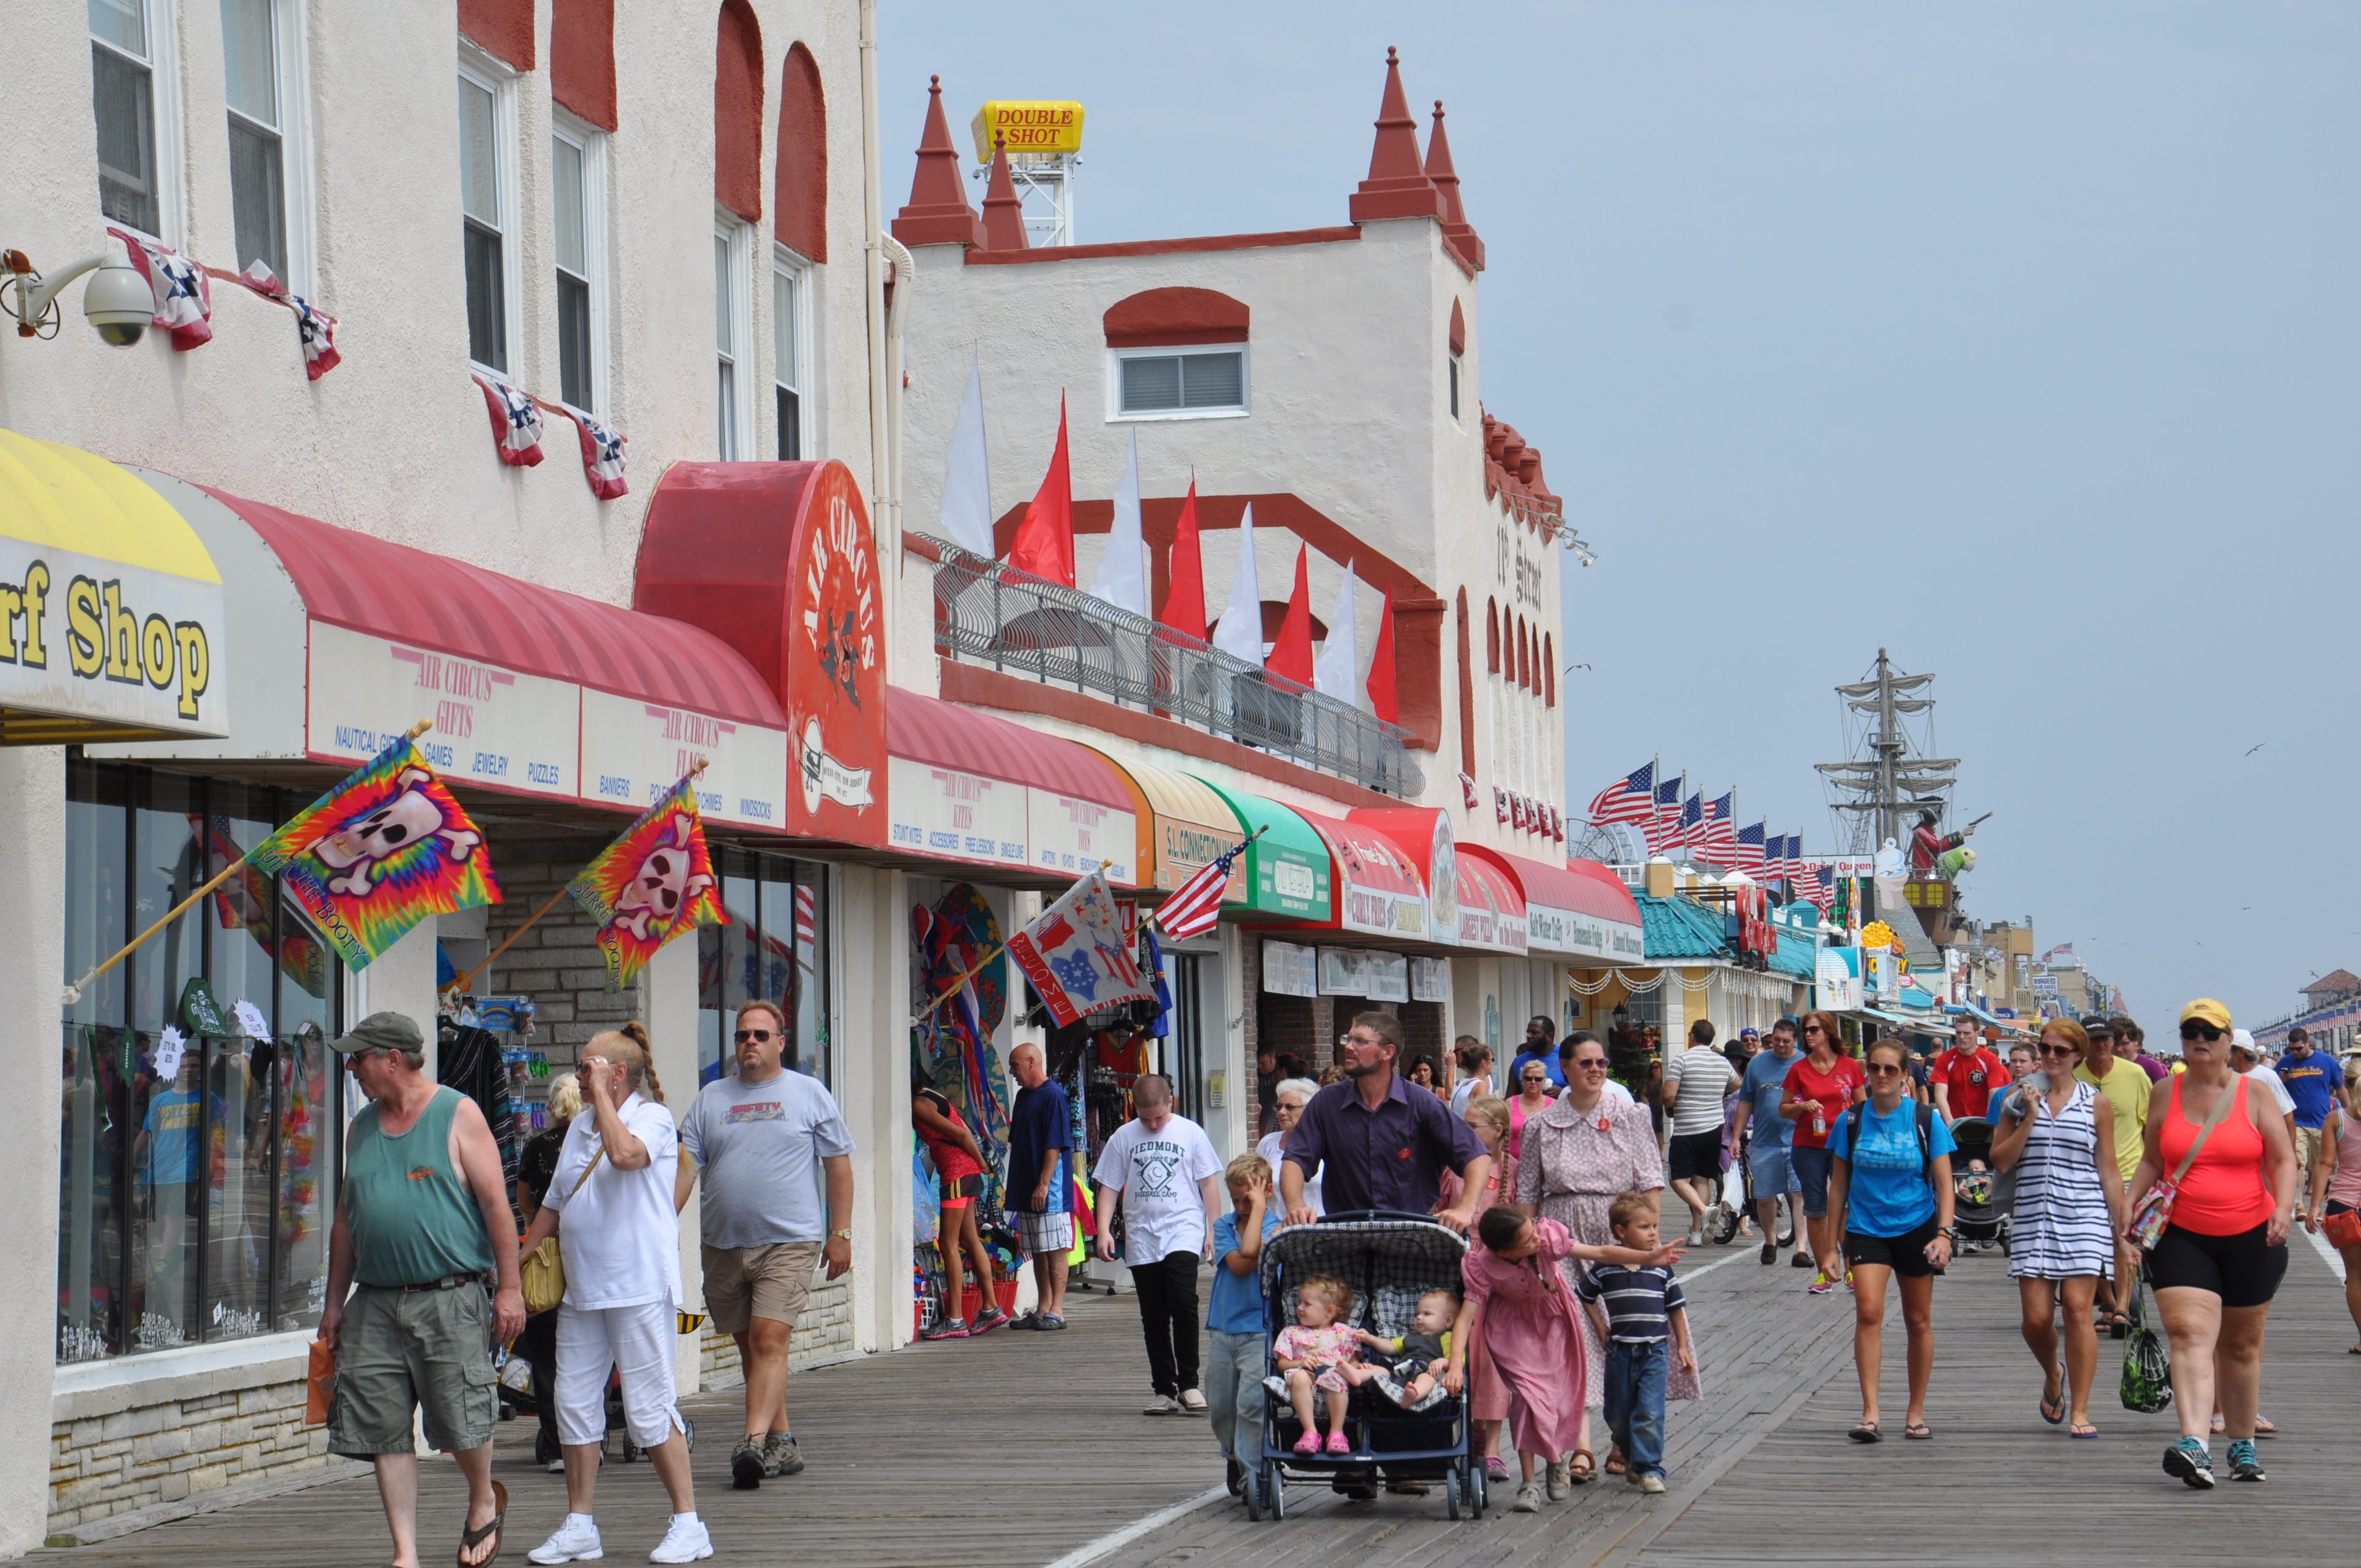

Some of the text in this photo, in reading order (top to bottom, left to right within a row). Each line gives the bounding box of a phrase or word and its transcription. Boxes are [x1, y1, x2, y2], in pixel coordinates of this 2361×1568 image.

[997, 110, 1073, 124] DOUBLE
[1009, 128, 1061, 144] SHOT
[1497, 523, 1541, 614] 11th Street
[804, 496, 874, 670] AIR CIRCUS
[67, 574, 209, 721] Shop
[414, 655, 492, 702] AIR CIRCUS
[436, 700, 474, 738] GIFTS
[662, 710, 719, 749] AIR CIRCUS
[335, 725, 377, 753] NAUTICAL
[425, 742, 453, 767] GAMES
[472, 752, 509, 777] JEWELRY
[528, 762, 559, 786] PUZZLES
[600, 775, 630, 798] BANNERS
[850, 776, 863, 788] JERSEY
[943, 773, 981, 802] AIR CIRCUS
[701, 792, 722, 812] CHIMES
[740, 798, 771, 820] WINDSOCKS
[1069, 801, 1098, 827] AIR CIRCUS
[953, 804, 972, 830] KITES
[893, 823, 922, 844] STUNT KITES
[929, 831, 959, 850] ACCESSORIES
[965, 837, 995, 855] FREE LESSONS
[1078, 829, 1090, 852] TOYS
[1167, 824, 1179, 859] S.L.
[1179, 827, 1221, 864] CONNECTION
[1001, 842, 1024, 859] SINGLE LINE
[1839, 862, 1872, 873] Queen
[295, 868, 325, 903] THE
[1352, 891, 1370, 925] CURLY
[1371, 895, 1386, 928] FRIES
[314, 902, 368, 961] BOOTY
[1460, 912, 1479, 942] LARGEST
[1480, 915, 1493, 943] PIZZA
[1510, 921, 1526, 949] Boardwalk
[1530, 912, 1563, 947] Salt Water Taffy
[1573, 920, 1602, 954] Homemade Fudge
[601, 931, 622, 986] BOOTY
[1011, 935, 1071, 1015] WELCOME
[732, 1102, 781, 1114] SAFETY
[1129, 1141, 1185, 1159] PIEDMONT
[1870, 1131, 1916, 1150] AM
[1139, 1156, 1174, 1165] SUMMER
